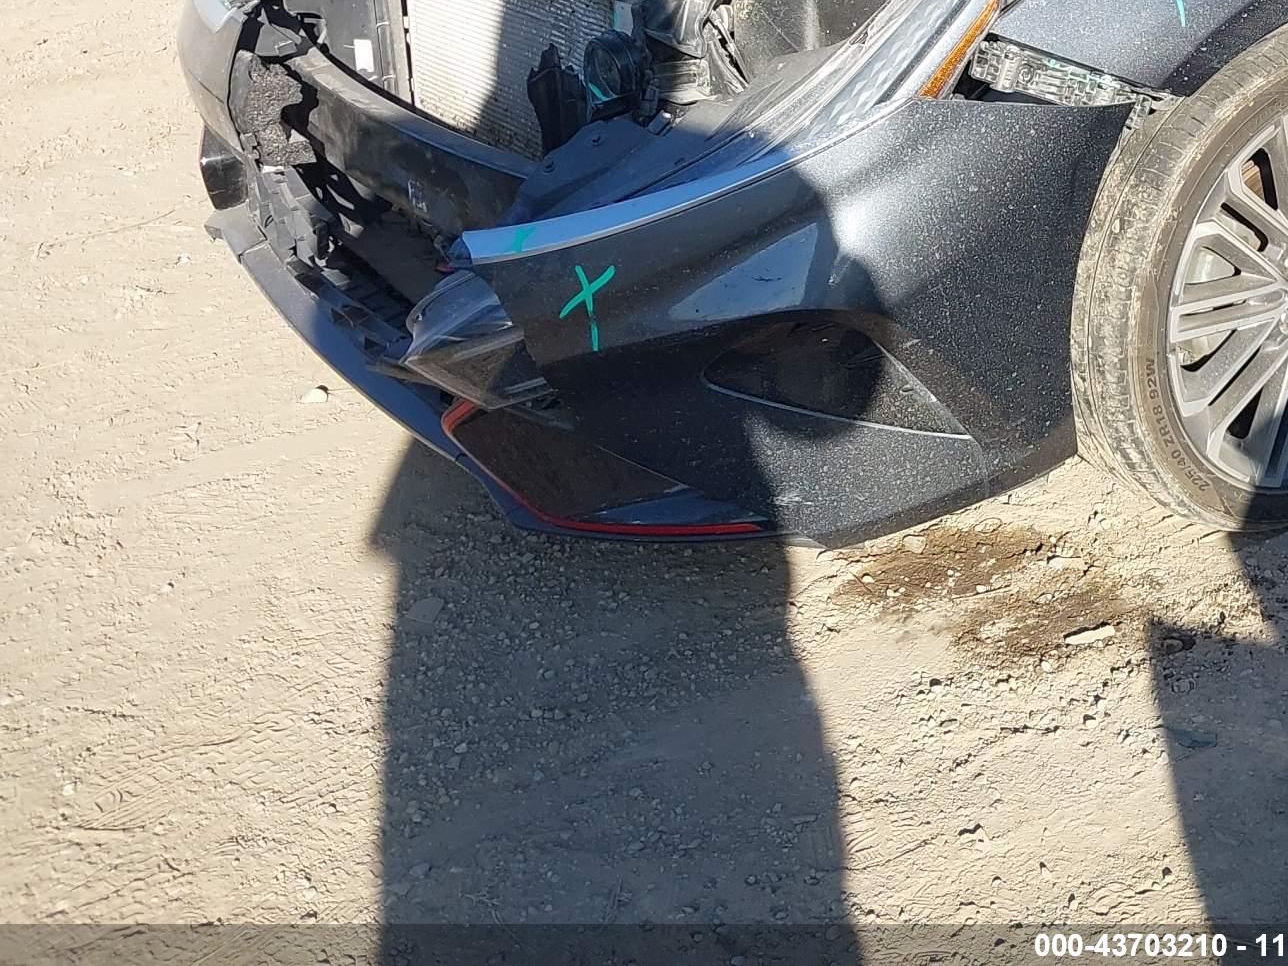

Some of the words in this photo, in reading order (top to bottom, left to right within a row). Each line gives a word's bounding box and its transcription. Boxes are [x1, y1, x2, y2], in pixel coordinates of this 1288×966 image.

[1145, 359, 1160, 400] 92W
[1153, 404, 1175, 447] ZR18
[1171, 449, 1210, 491] 225/40
